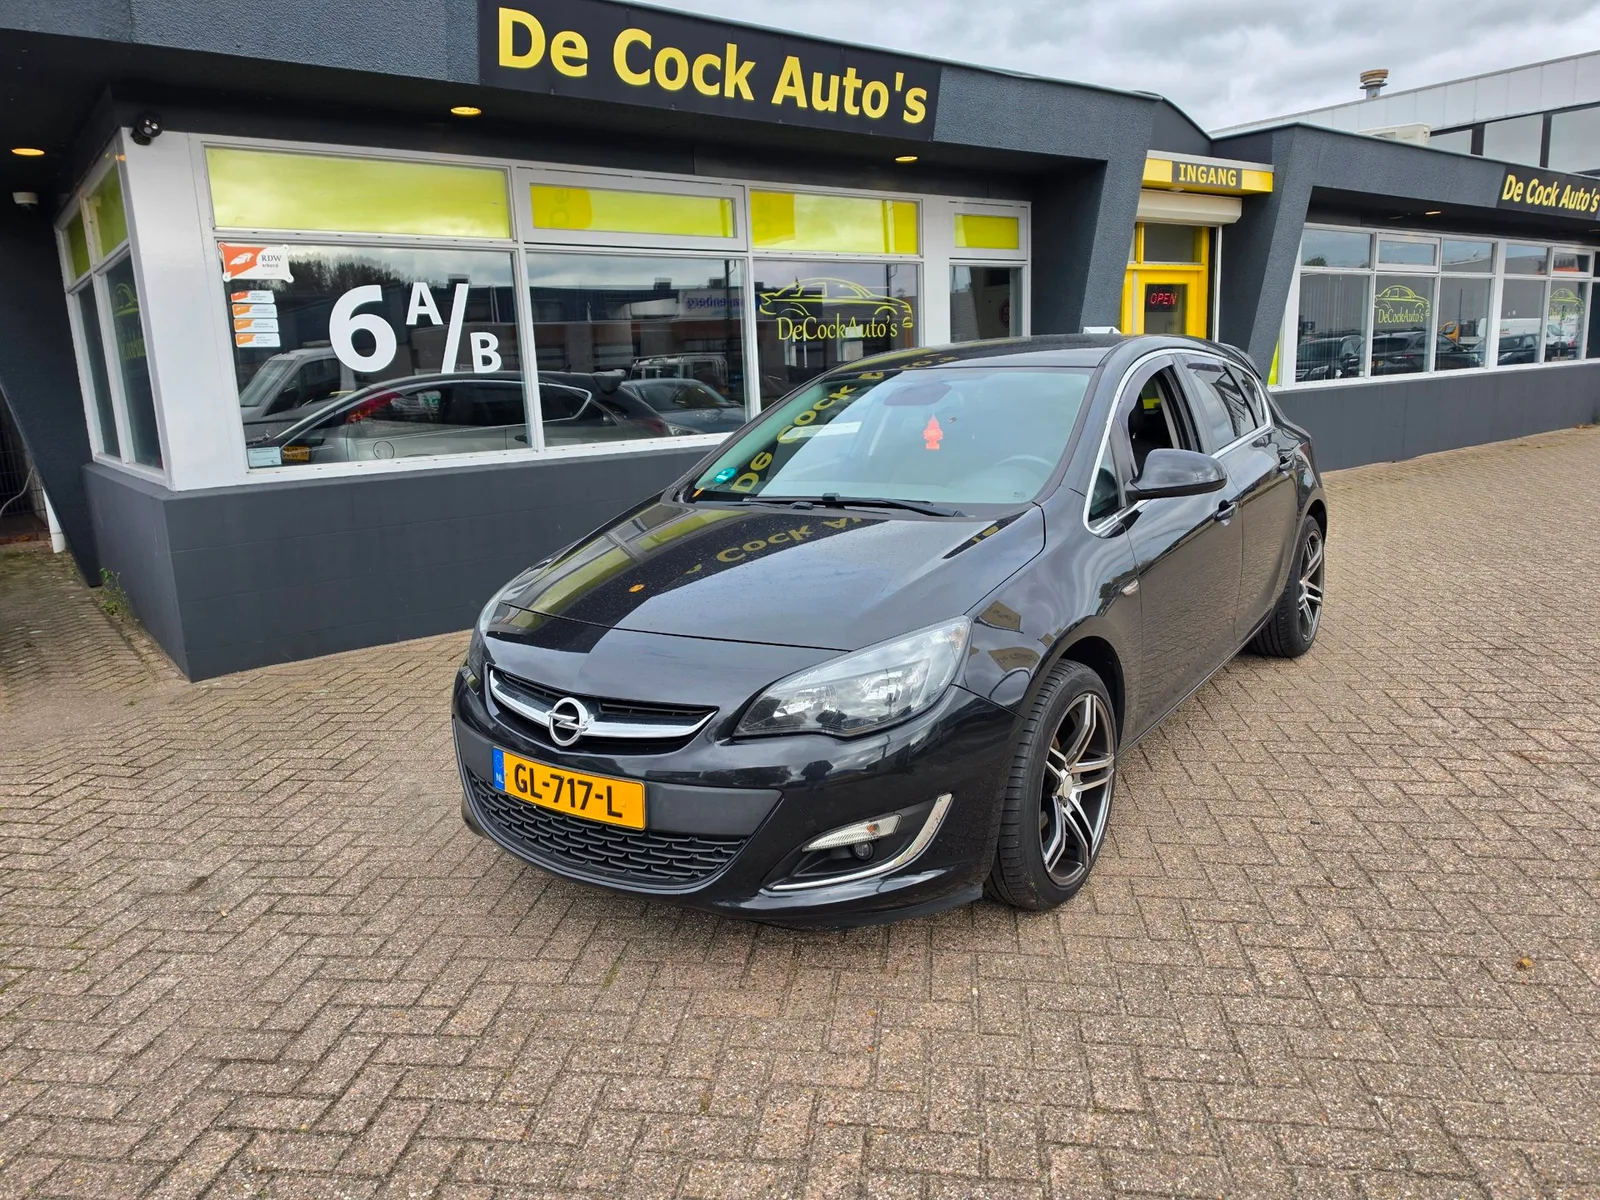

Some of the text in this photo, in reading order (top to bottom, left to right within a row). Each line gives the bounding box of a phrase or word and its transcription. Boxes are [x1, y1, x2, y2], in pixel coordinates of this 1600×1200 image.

[498, 7, 928, 124] De Cock Auto's
[1179, 163, 1237, 186] INGANG
[1502, 174, 1600, 213] De Cock Auto's
[261, 254, 282, 262] RDW
[1150, 293, 1178, 305] OPEN
[776, 312, 898, 341] DeCockAuto's
[513, 762, 624, 819] GL-717-L
